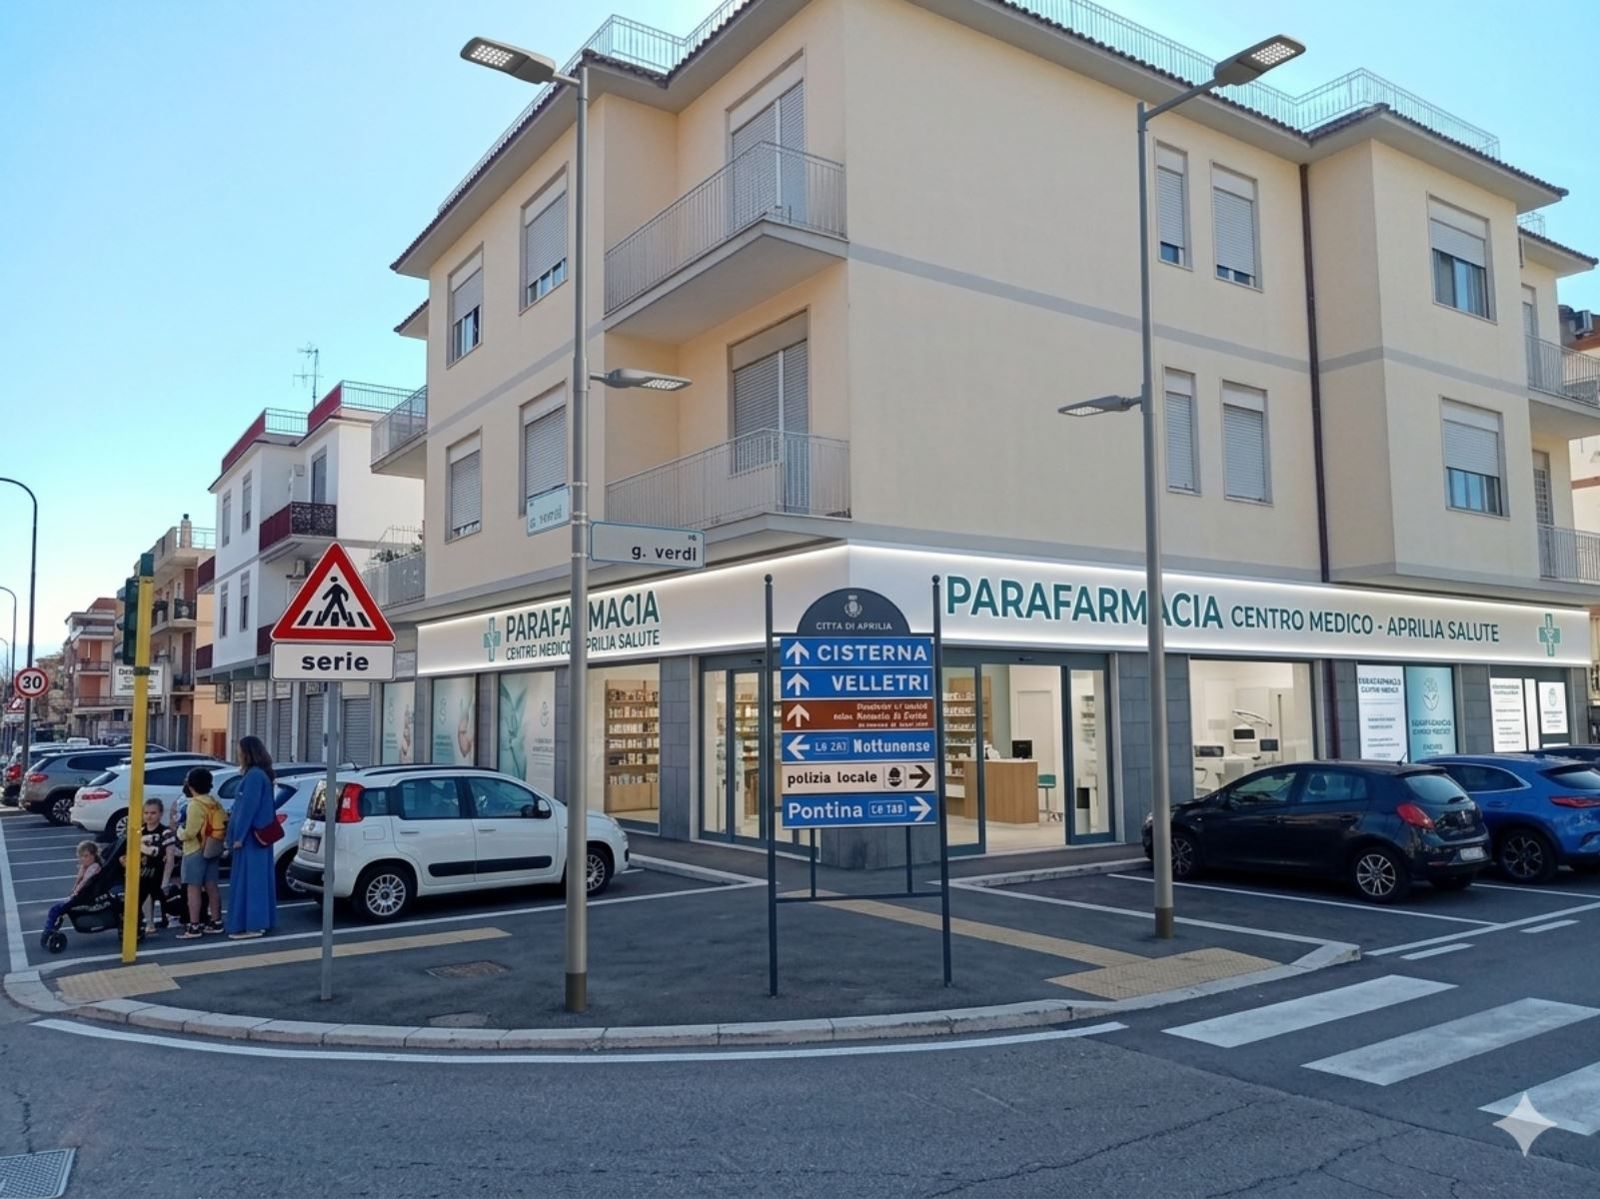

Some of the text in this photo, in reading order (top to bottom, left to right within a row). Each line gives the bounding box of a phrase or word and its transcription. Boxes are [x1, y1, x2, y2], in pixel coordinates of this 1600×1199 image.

[631, 546, 697, 562] g. verdi
[505, 590, 660, 643] PARAFAMACIA
[1230, 605, 1304, 631] CENTRO
[1309, 611, 1373, 635] MEDICO
[1386, 616, 1445, 639] APRILIA
[1447, 620, 1500, 642] SALUTE
[845, 621, 856, 631] DI
[857, 621, 893, 631] APRILIA
[586, 635, 616, 652] PRILIA
[618, 629, 660, 649] SALUTE
[301, 651, 370, 671] serie
[817, 645, 928, 662] CISTERNA
[22, 675, 43, 690] 30
[832, 675, 929, 692] VELLETRI
[787, 770, 878, 788] polizia locale
[788, 801, 863, 819] Pontina
